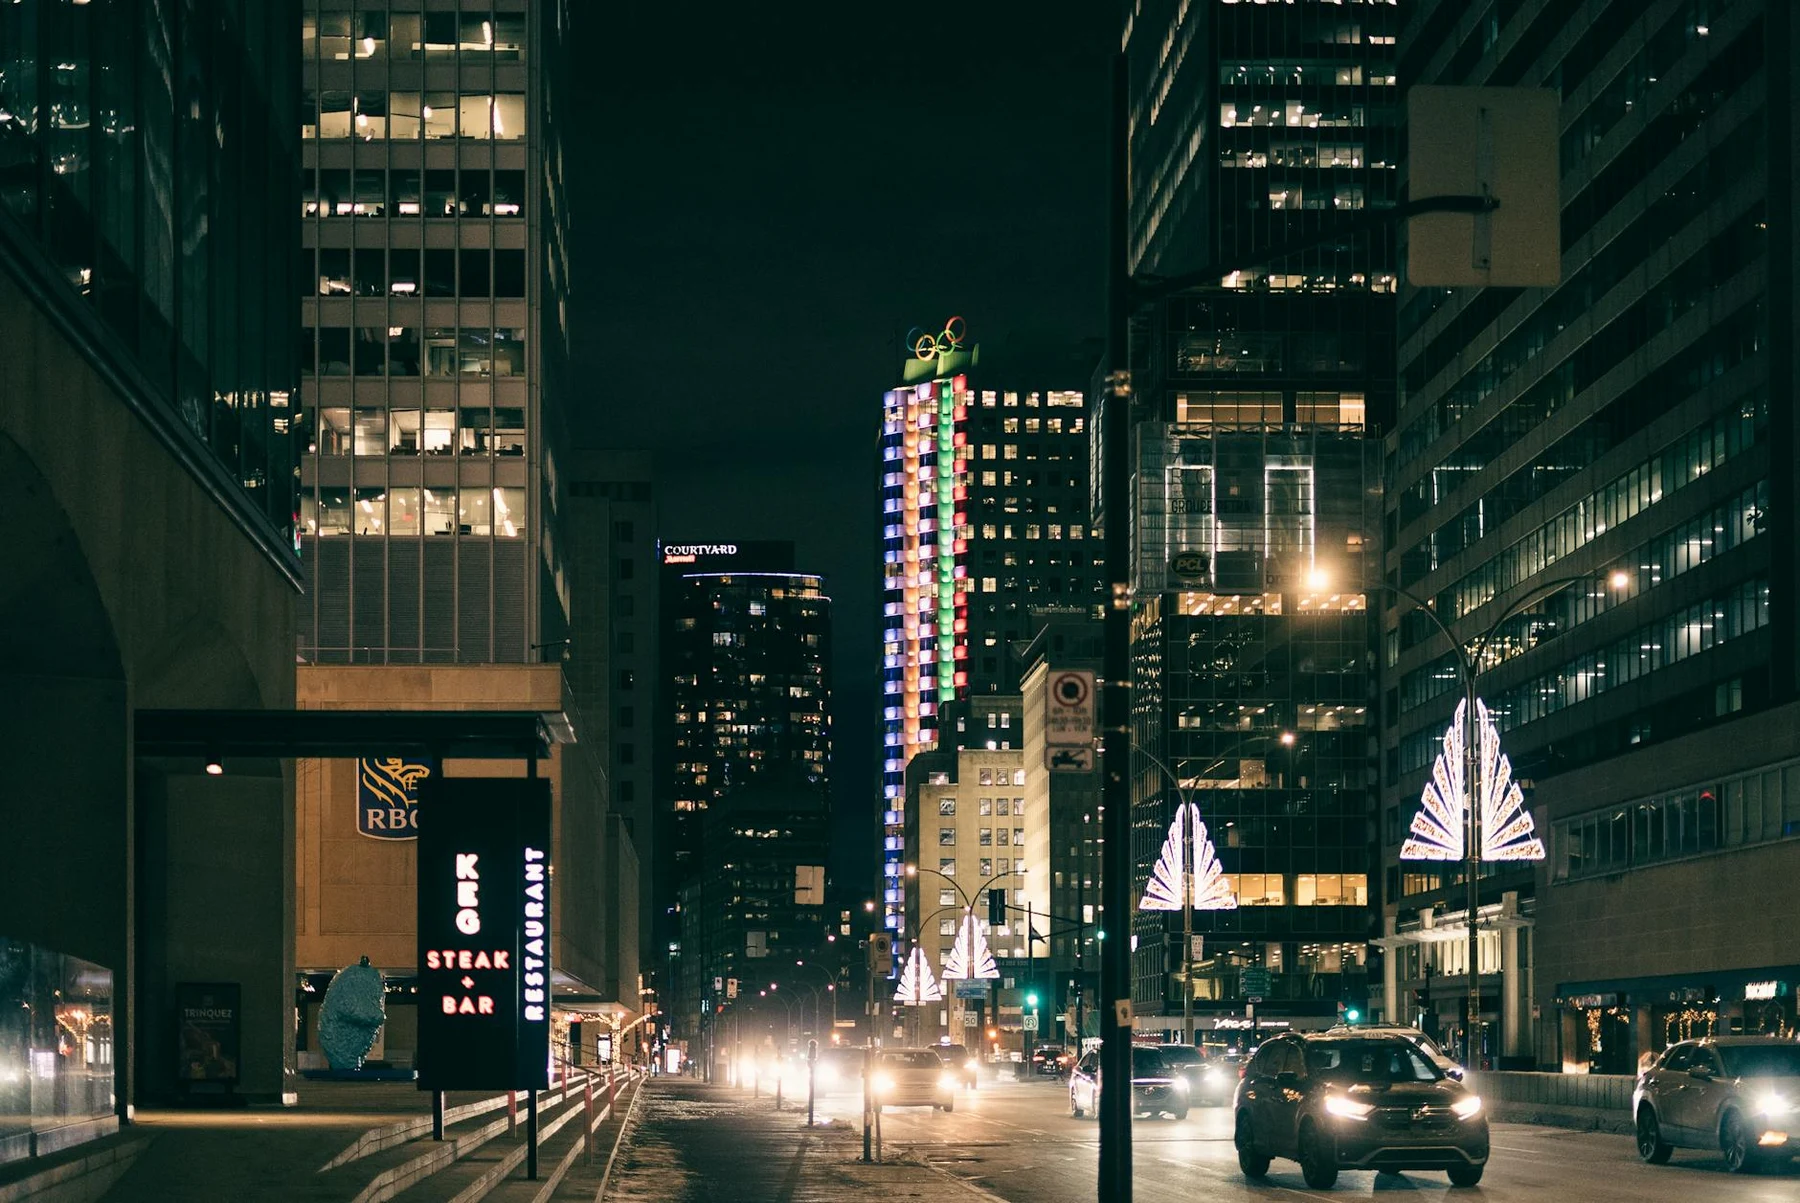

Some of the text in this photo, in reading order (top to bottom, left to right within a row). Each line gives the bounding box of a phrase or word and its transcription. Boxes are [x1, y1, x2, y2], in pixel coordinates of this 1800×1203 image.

[664, 544, 738, 555] COURTYARD
[1175, 558, 1206, 571] PCL
[455, 853, 481, 935] KEG
[524, 847, 545, 1021] RESTAURANT
[426, 949, 510, 970] STEAK
[442, 995, 495, 1015] BAR
[183, 1007, 233, 1020] TRINQUEZ
[965, 1017, 976, 1025] 50
